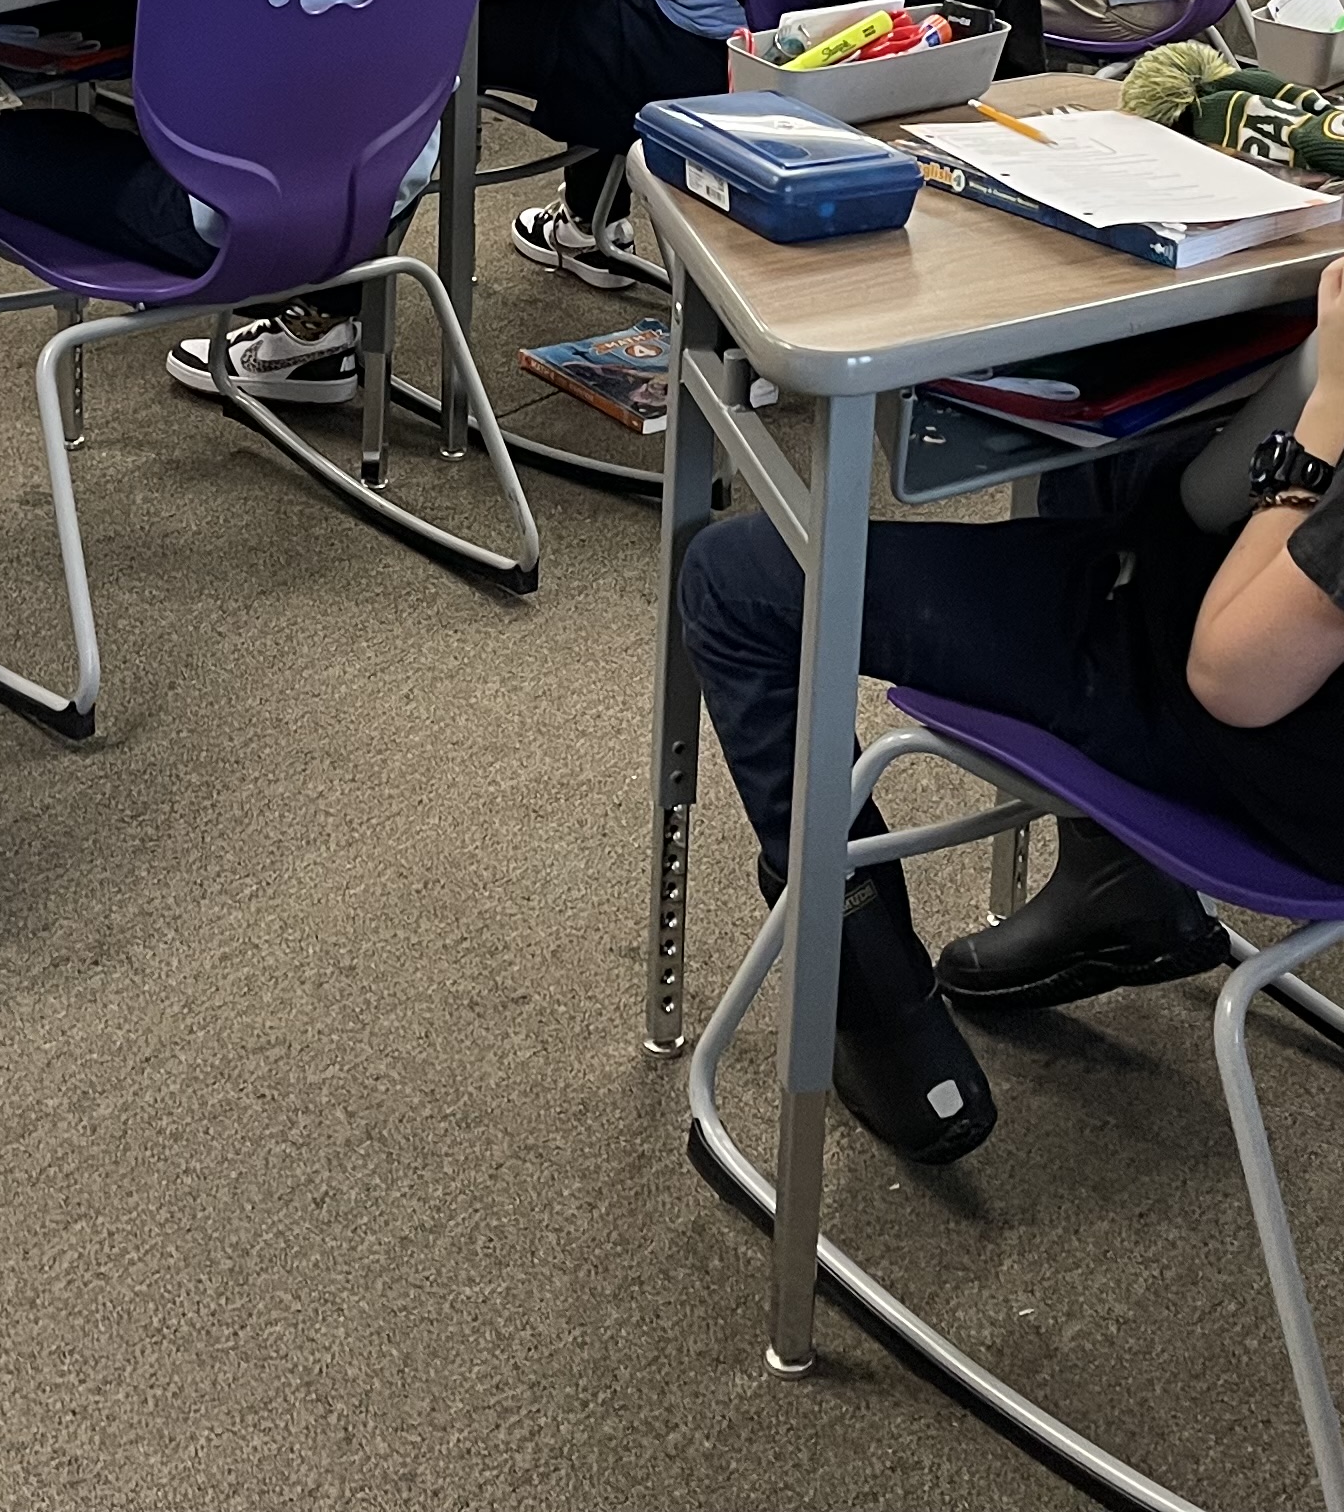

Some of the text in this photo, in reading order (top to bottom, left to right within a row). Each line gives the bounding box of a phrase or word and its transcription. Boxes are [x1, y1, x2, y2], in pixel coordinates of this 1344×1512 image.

[918, 162, 953, 184] glish
[604, 335, 645, 349] MATH
[634, 345, 656, 357] 4
